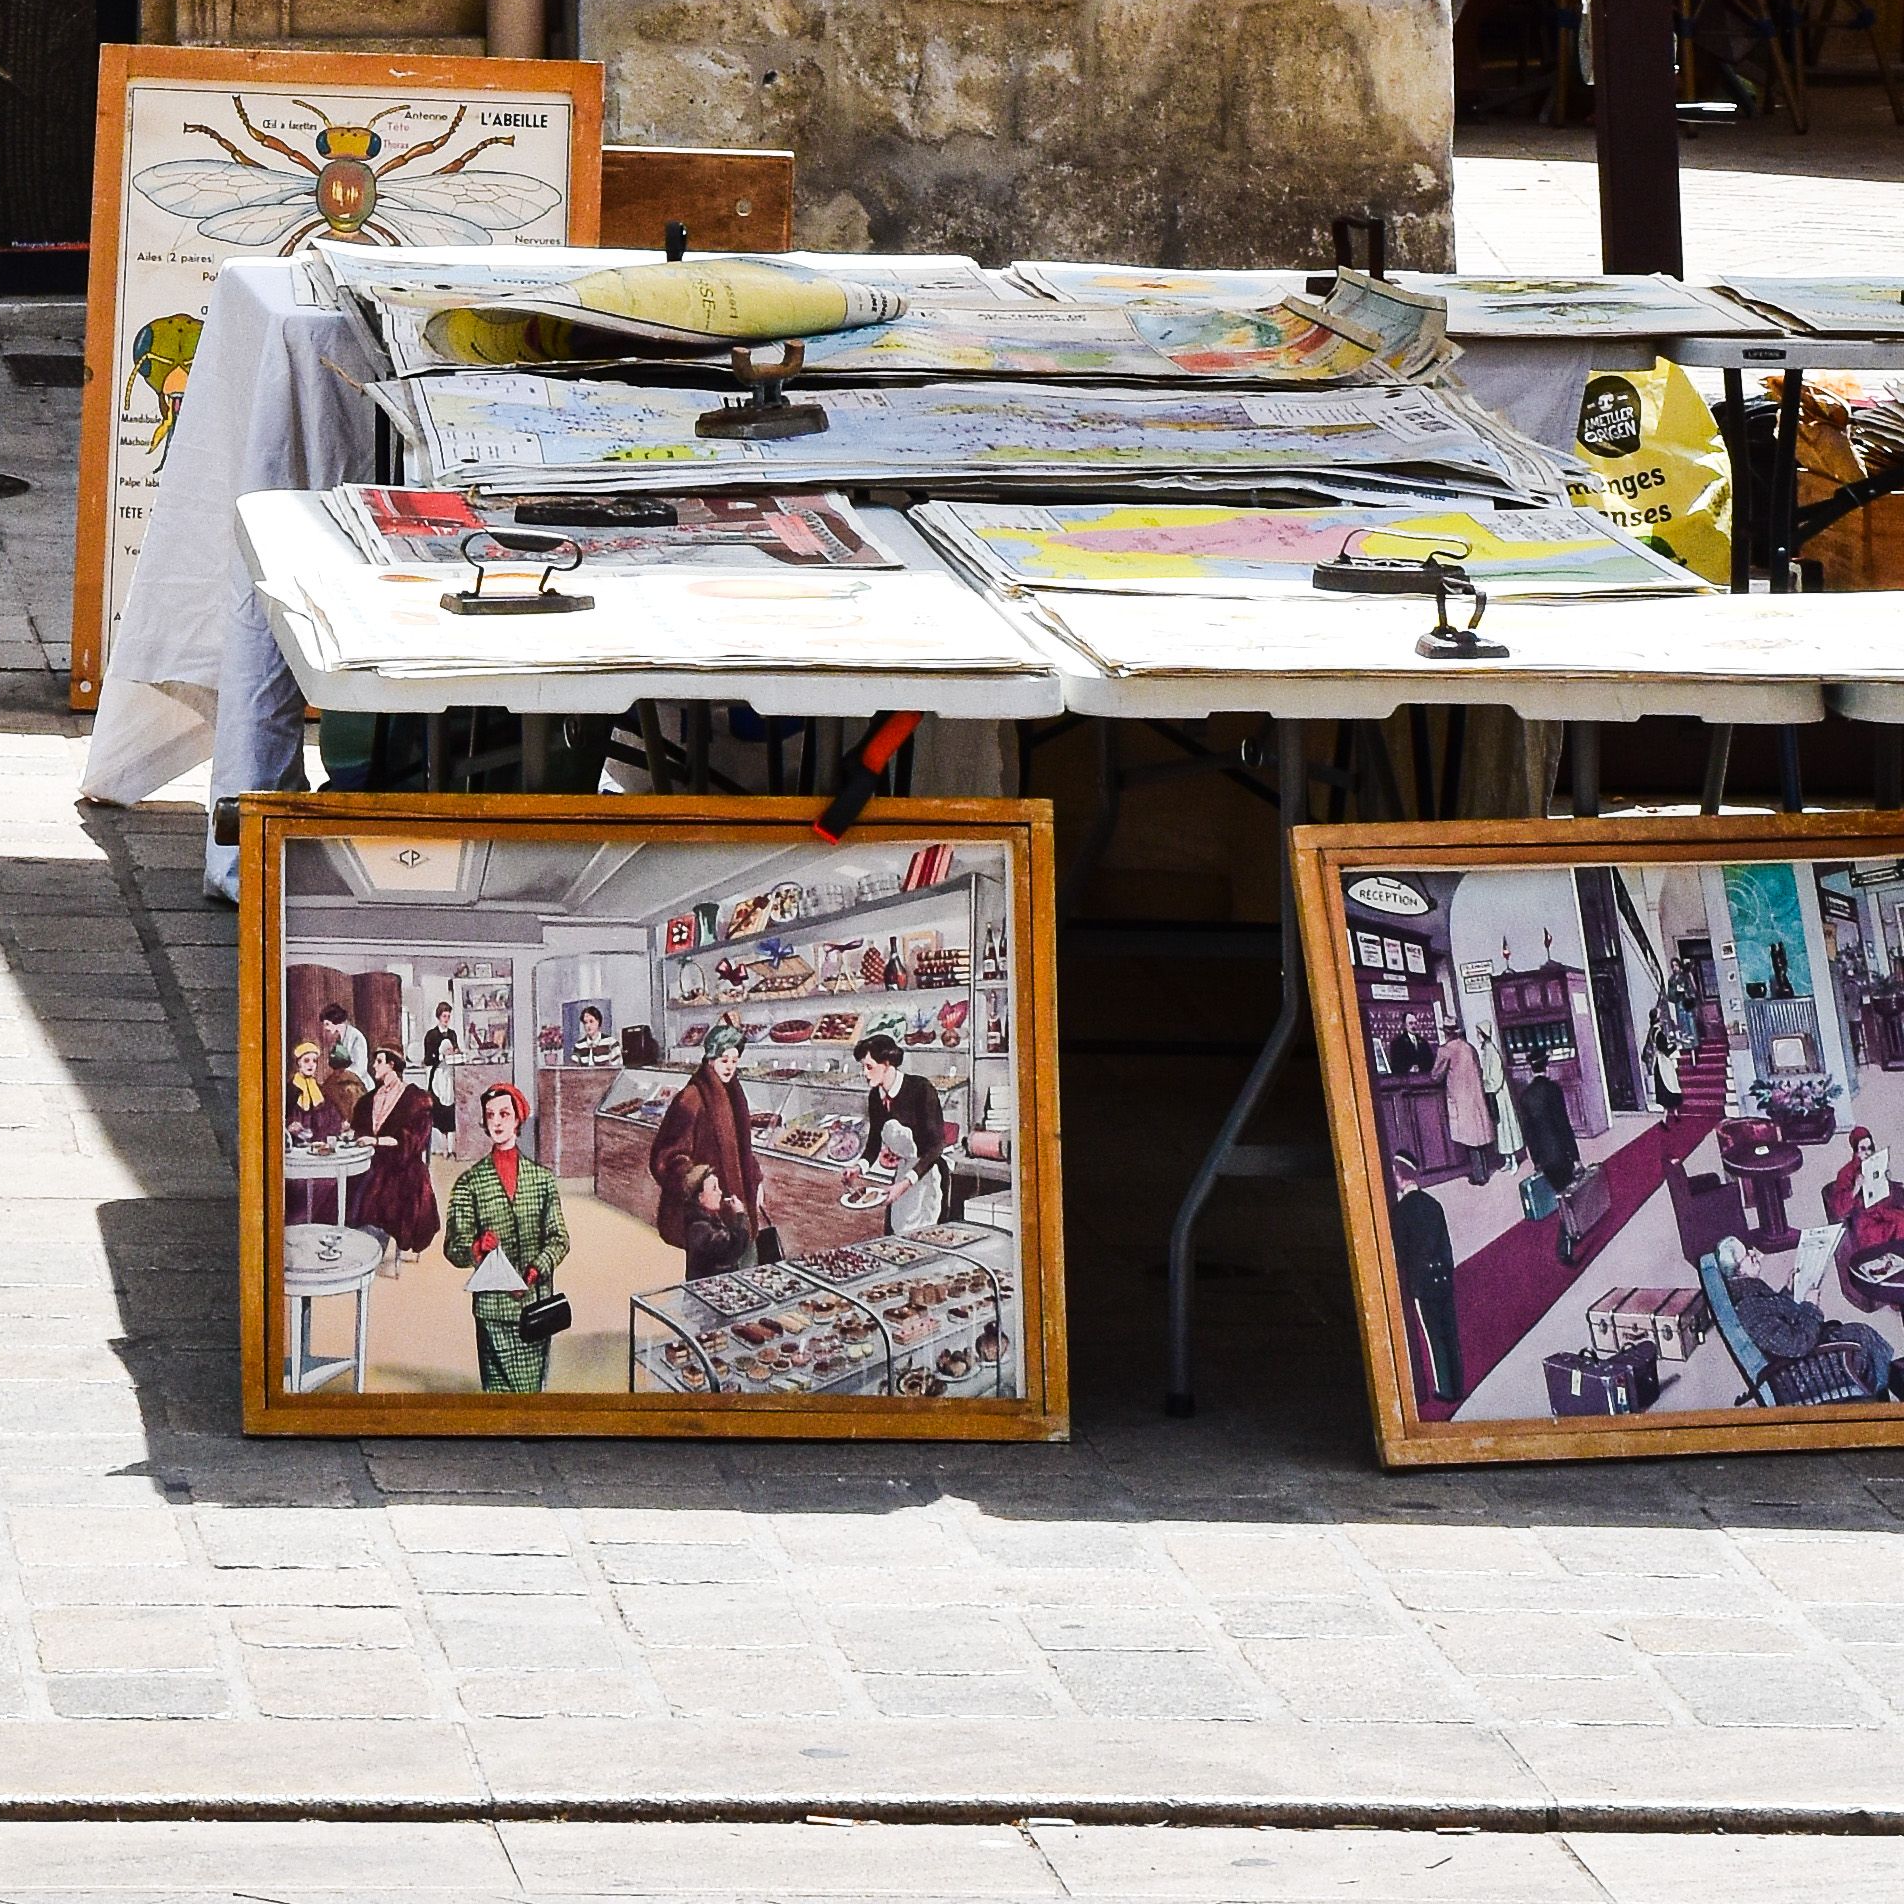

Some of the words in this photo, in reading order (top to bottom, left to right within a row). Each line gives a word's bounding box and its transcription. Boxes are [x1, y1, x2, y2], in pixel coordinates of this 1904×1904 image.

[404, 110, 448, 123] Antenne
[480, 111, 549, 129] L'ABEILLE
[514, 234, 561, 248] Nervures
[137, 251, 163, 262] Ailes
[119, 476, 141, 488] Palpe
